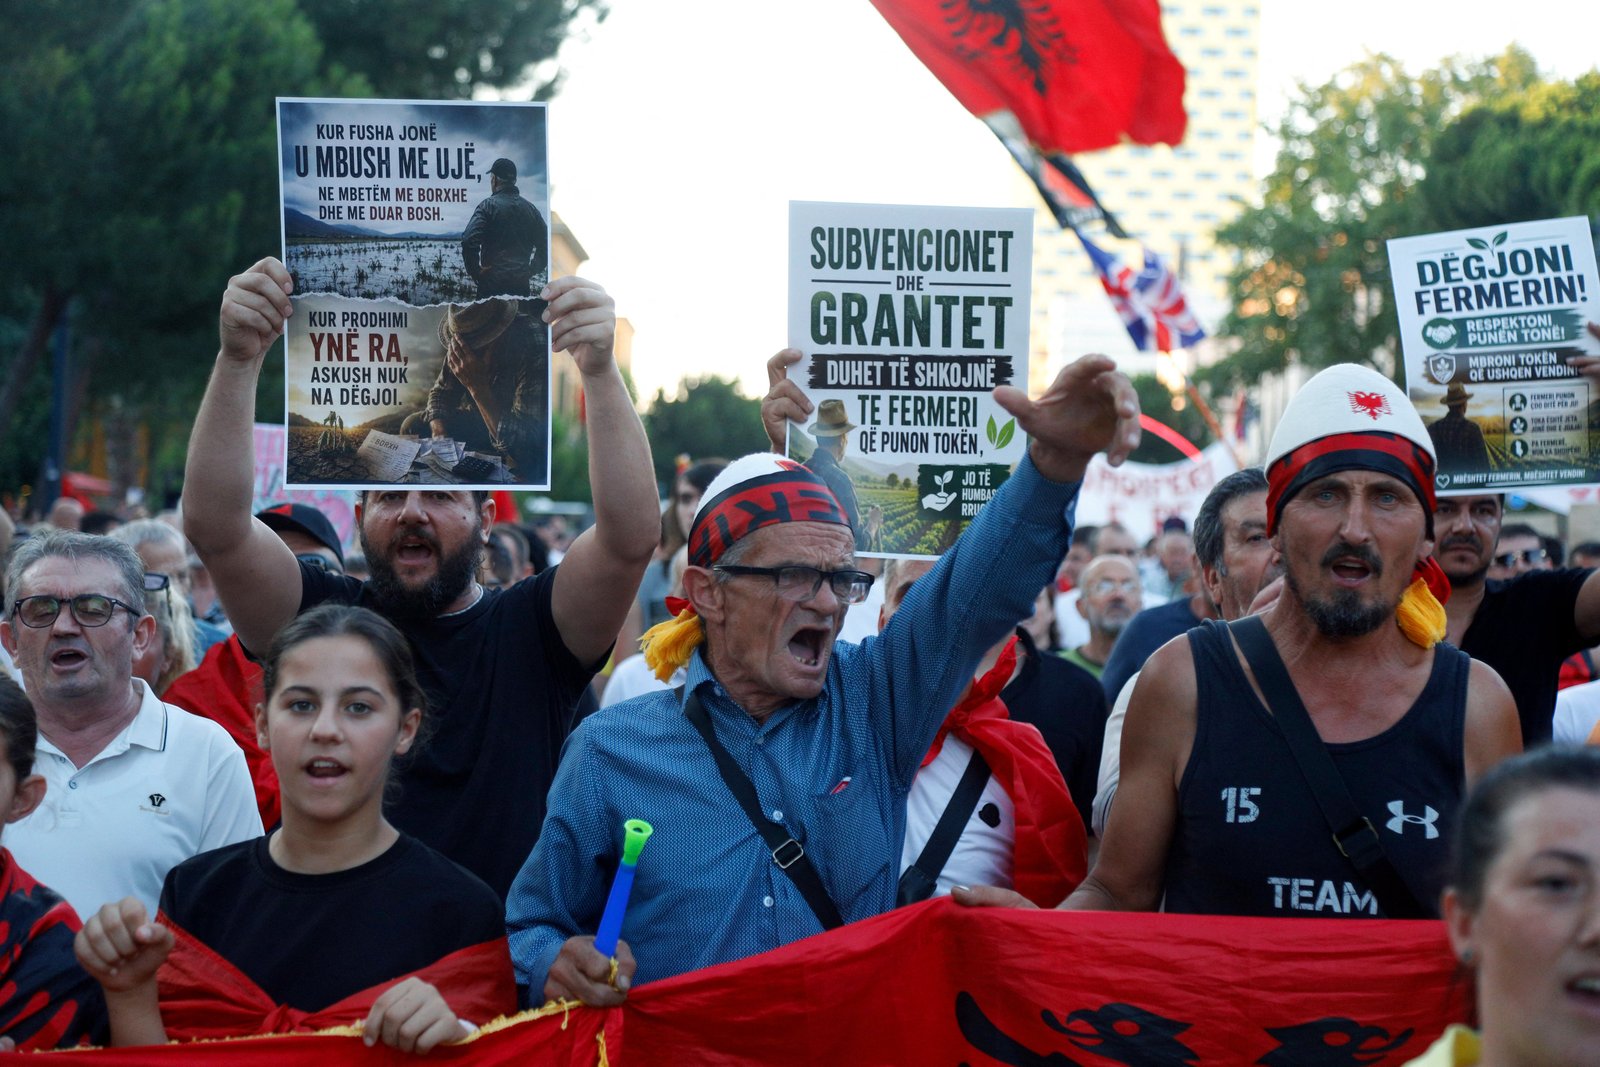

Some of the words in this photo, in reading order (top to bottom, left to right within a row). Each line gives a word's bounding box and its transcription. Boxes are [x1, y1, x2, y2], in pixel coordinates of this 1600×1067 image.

[316, 124, 345, 140] KUR
[349, 124, 394, 141] FUSHA
[398, 123, 437, 141] JONË
[295, 145, 309, 178] U
[316, 145, 391, 179] MBUSH
[399, 147, 429, 179] ME
[436, 142, 482, 183] UJË,
[318, 186, 334, 202] NE
[339, 184, 391, 202] MBETËM
[395, 187, 414, 203] ME
[418, 187, 468, 203] BORXHE
[319, 205, 343, 220] DHE
[347, 205, 365, 220] ME
[369, 206, 403, 221] DUAR
[407, 206, 445, 221] BOSH.
[810, 226, 1014, 273] SUBVENCIONET
[1416, 244, 1574, 287] DËGJONI
[896, 275, 924, 292] DHE
[1414, 274, 1588, 316] FERMERIN!
[308, 311, 336, 328] KUR
[341, 311, 408, 328] PRODHIMI
[810, 290, 1013, 350] GRANTET
[1466, 314, 1552, 332] RESPEKTONI
[1468, 328, 1518, 346] PUNËN
[1521, 324, 1566, 343] TONË!
[309, 328, 360, 363] YNË
[368, 333, 409, 366] RA,
[1469, 353, 1516, 369] MBRONI
[1519, 351, 1558, 366] TOKËN
[310, 366, 372, 383] ASKUSH
[377, 367, 408, 384] NUK
[826, 360, 884, 386] DUHET
[888, 356, 909, 387] TË
[915, 358, 996, 388] SHKOJNË
[1469, 366, 1485, 382] QË
[1487, 366, 1532, 381] USHQEN
[311, 388, 334, 406] NA
[340, 385, 403, 406] DËGJOI.
[857, 394, 881, 426] TE
[889, 395, 978, 427] FERMERI
[374, 437, 399, 451] BORXH
[859, 427, 877, 453] QË
[881, 430, 928, 454] PUNON
[933, 427, 984, 457] TOKËN,
[961, 471, 976, 486] JO
[978, 468, 991, 486] TË
[1221, 787, 1262, 823] 15
[1267, 876, 1379, 915] TEAM
